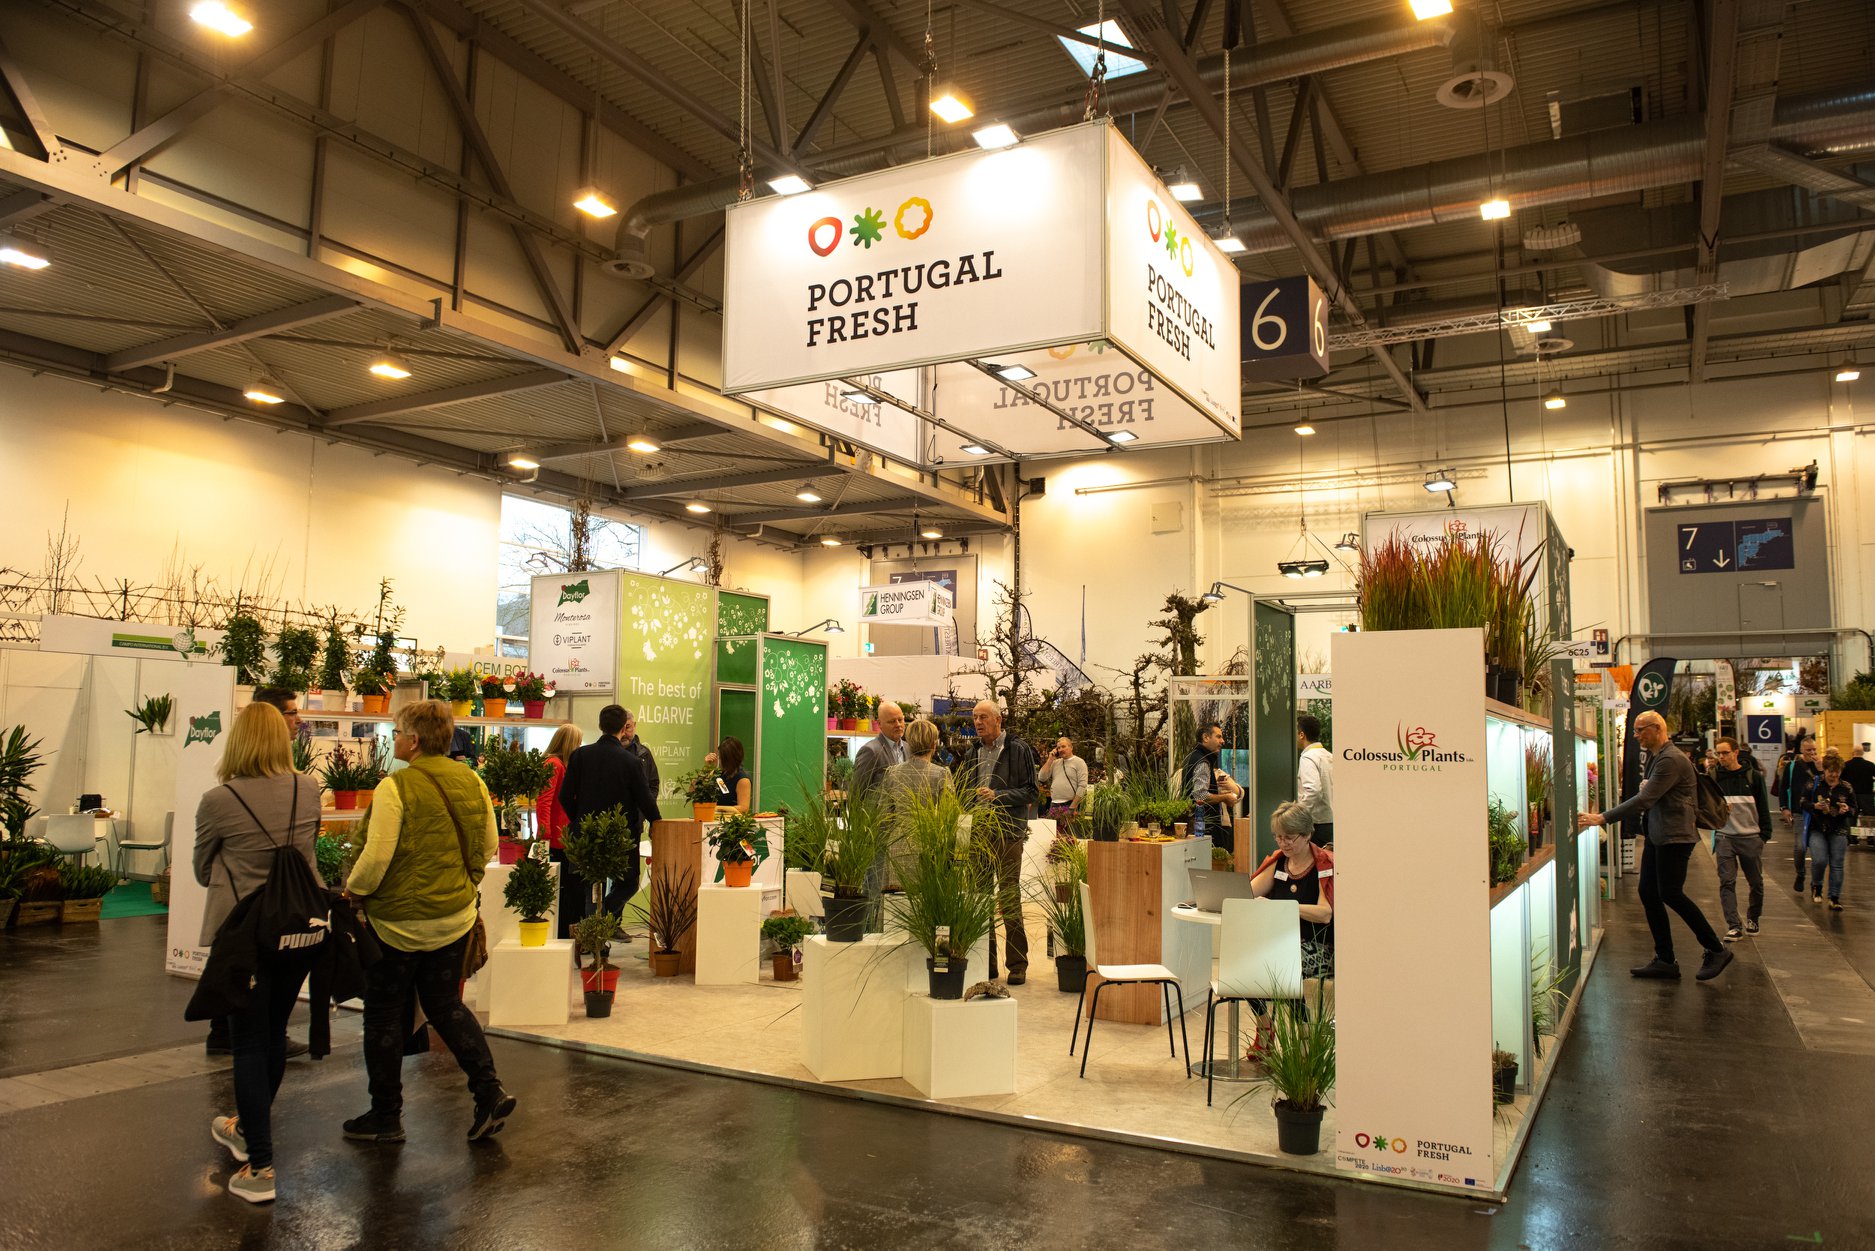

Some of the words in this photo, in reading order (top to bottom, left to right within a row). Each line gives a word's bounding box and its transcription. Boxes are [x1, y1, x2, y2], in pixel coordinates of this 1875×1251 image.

[807, 250, 1002, 312] PORTUGAL
[1147, 263, 1216, 350] PORTUGAL
[806, 301, 918, 347] FRESH
[1252, 287, 1287, 350] 6
[1315, 298, 1324, 357] 6
[1147, 300, 1191, 361] FRESH
[1682, 527, 1699, 550] 7
[562, 591, 585, 601] Dayflor
[880, 589, 925, 603] HENNINGSEN
[553, 612, 591, 622] Monterosa
[880, 603, 904, 615] GROUP
[562, 635, 591, 644] VIPLANT
[630, 676, 654, 696] The
[658, 678, 686, 698] best
[689, 681, 702, 699] of
[637, 704, 694, 725] ALGARVE
[190, 727, 216, 740] Dayflor
[1758, 719, 1772, 740] 6
[653, 745, 691, 757] VIPLANT
[1343, 747, 1403, 761] Colossus
[1421, 748, 1465, 763] Plants
[1383, 764, 1442, 772] PORTUGAL
[278, 928, 324, 950] PUMA
[1417, 1140, 1473, 1155] PORTUGAL
[1417, 1149, 1450, 1161] FRESH
